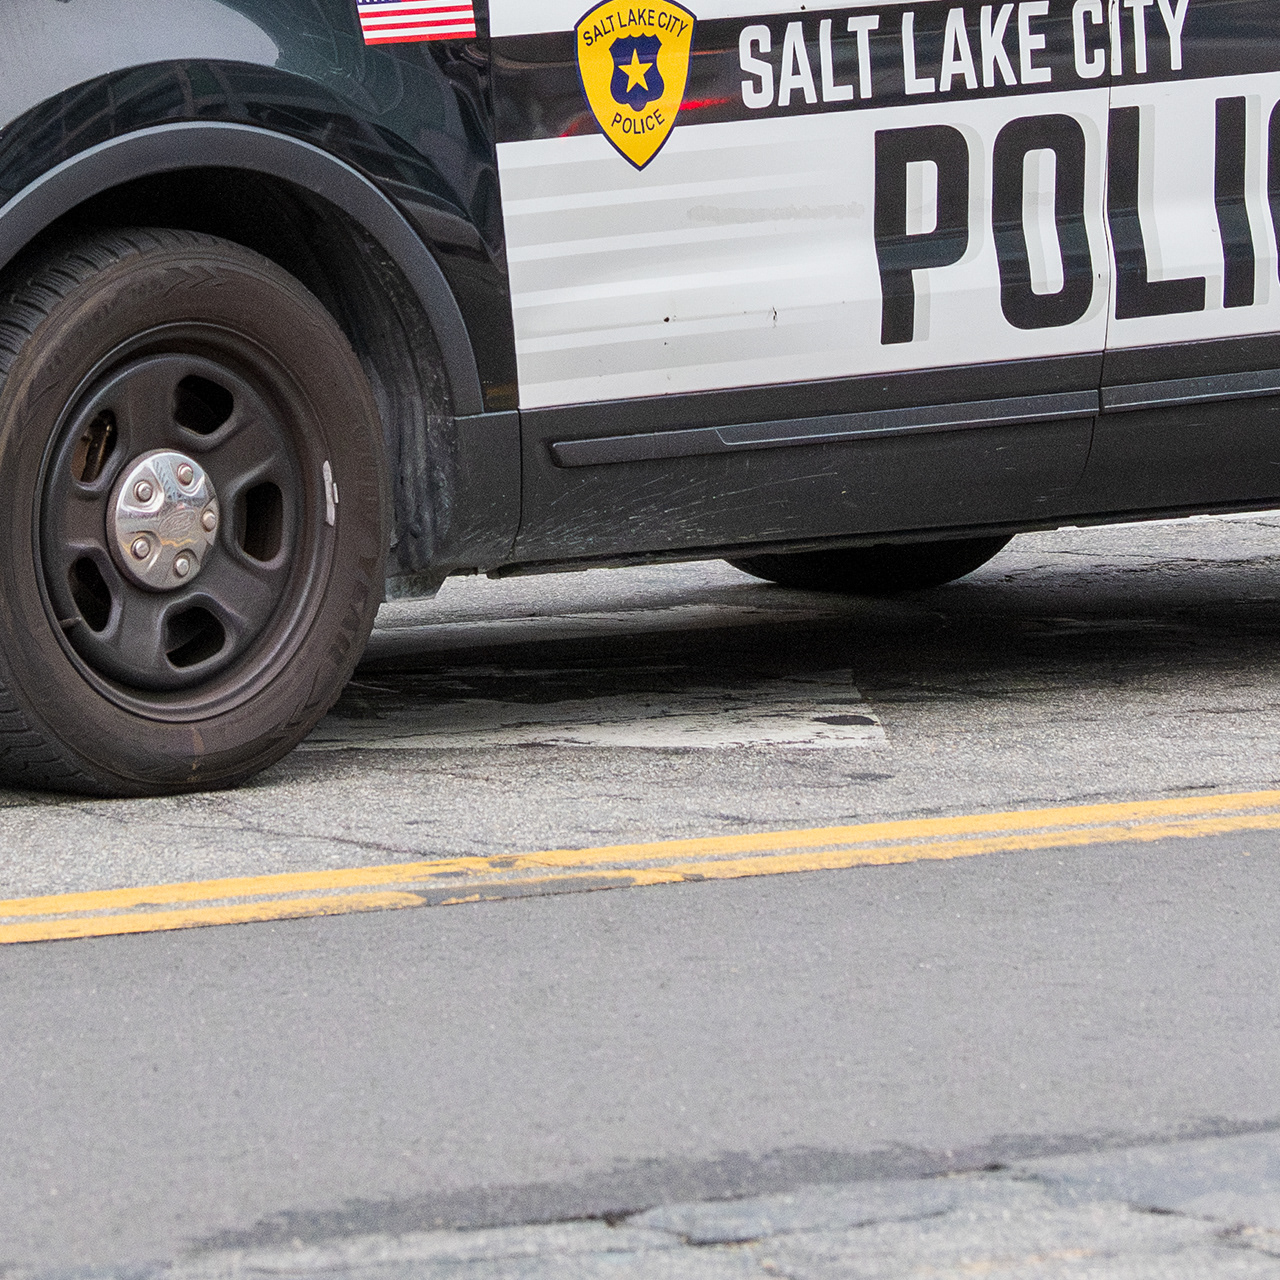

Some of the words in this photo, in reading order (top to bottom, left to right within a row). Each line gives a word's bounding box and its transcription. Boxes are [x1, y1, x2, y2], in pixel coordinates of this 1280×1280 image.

[582, 15, 616, 46] SALT
[617, 8, 655, 28] LAKE
[657, 11, 688, 37] CITY
[738, 14, 880, 110] SALT
[902, 0, 1053, 96] LAKE
[610, 109, 665, 134] POLICE
